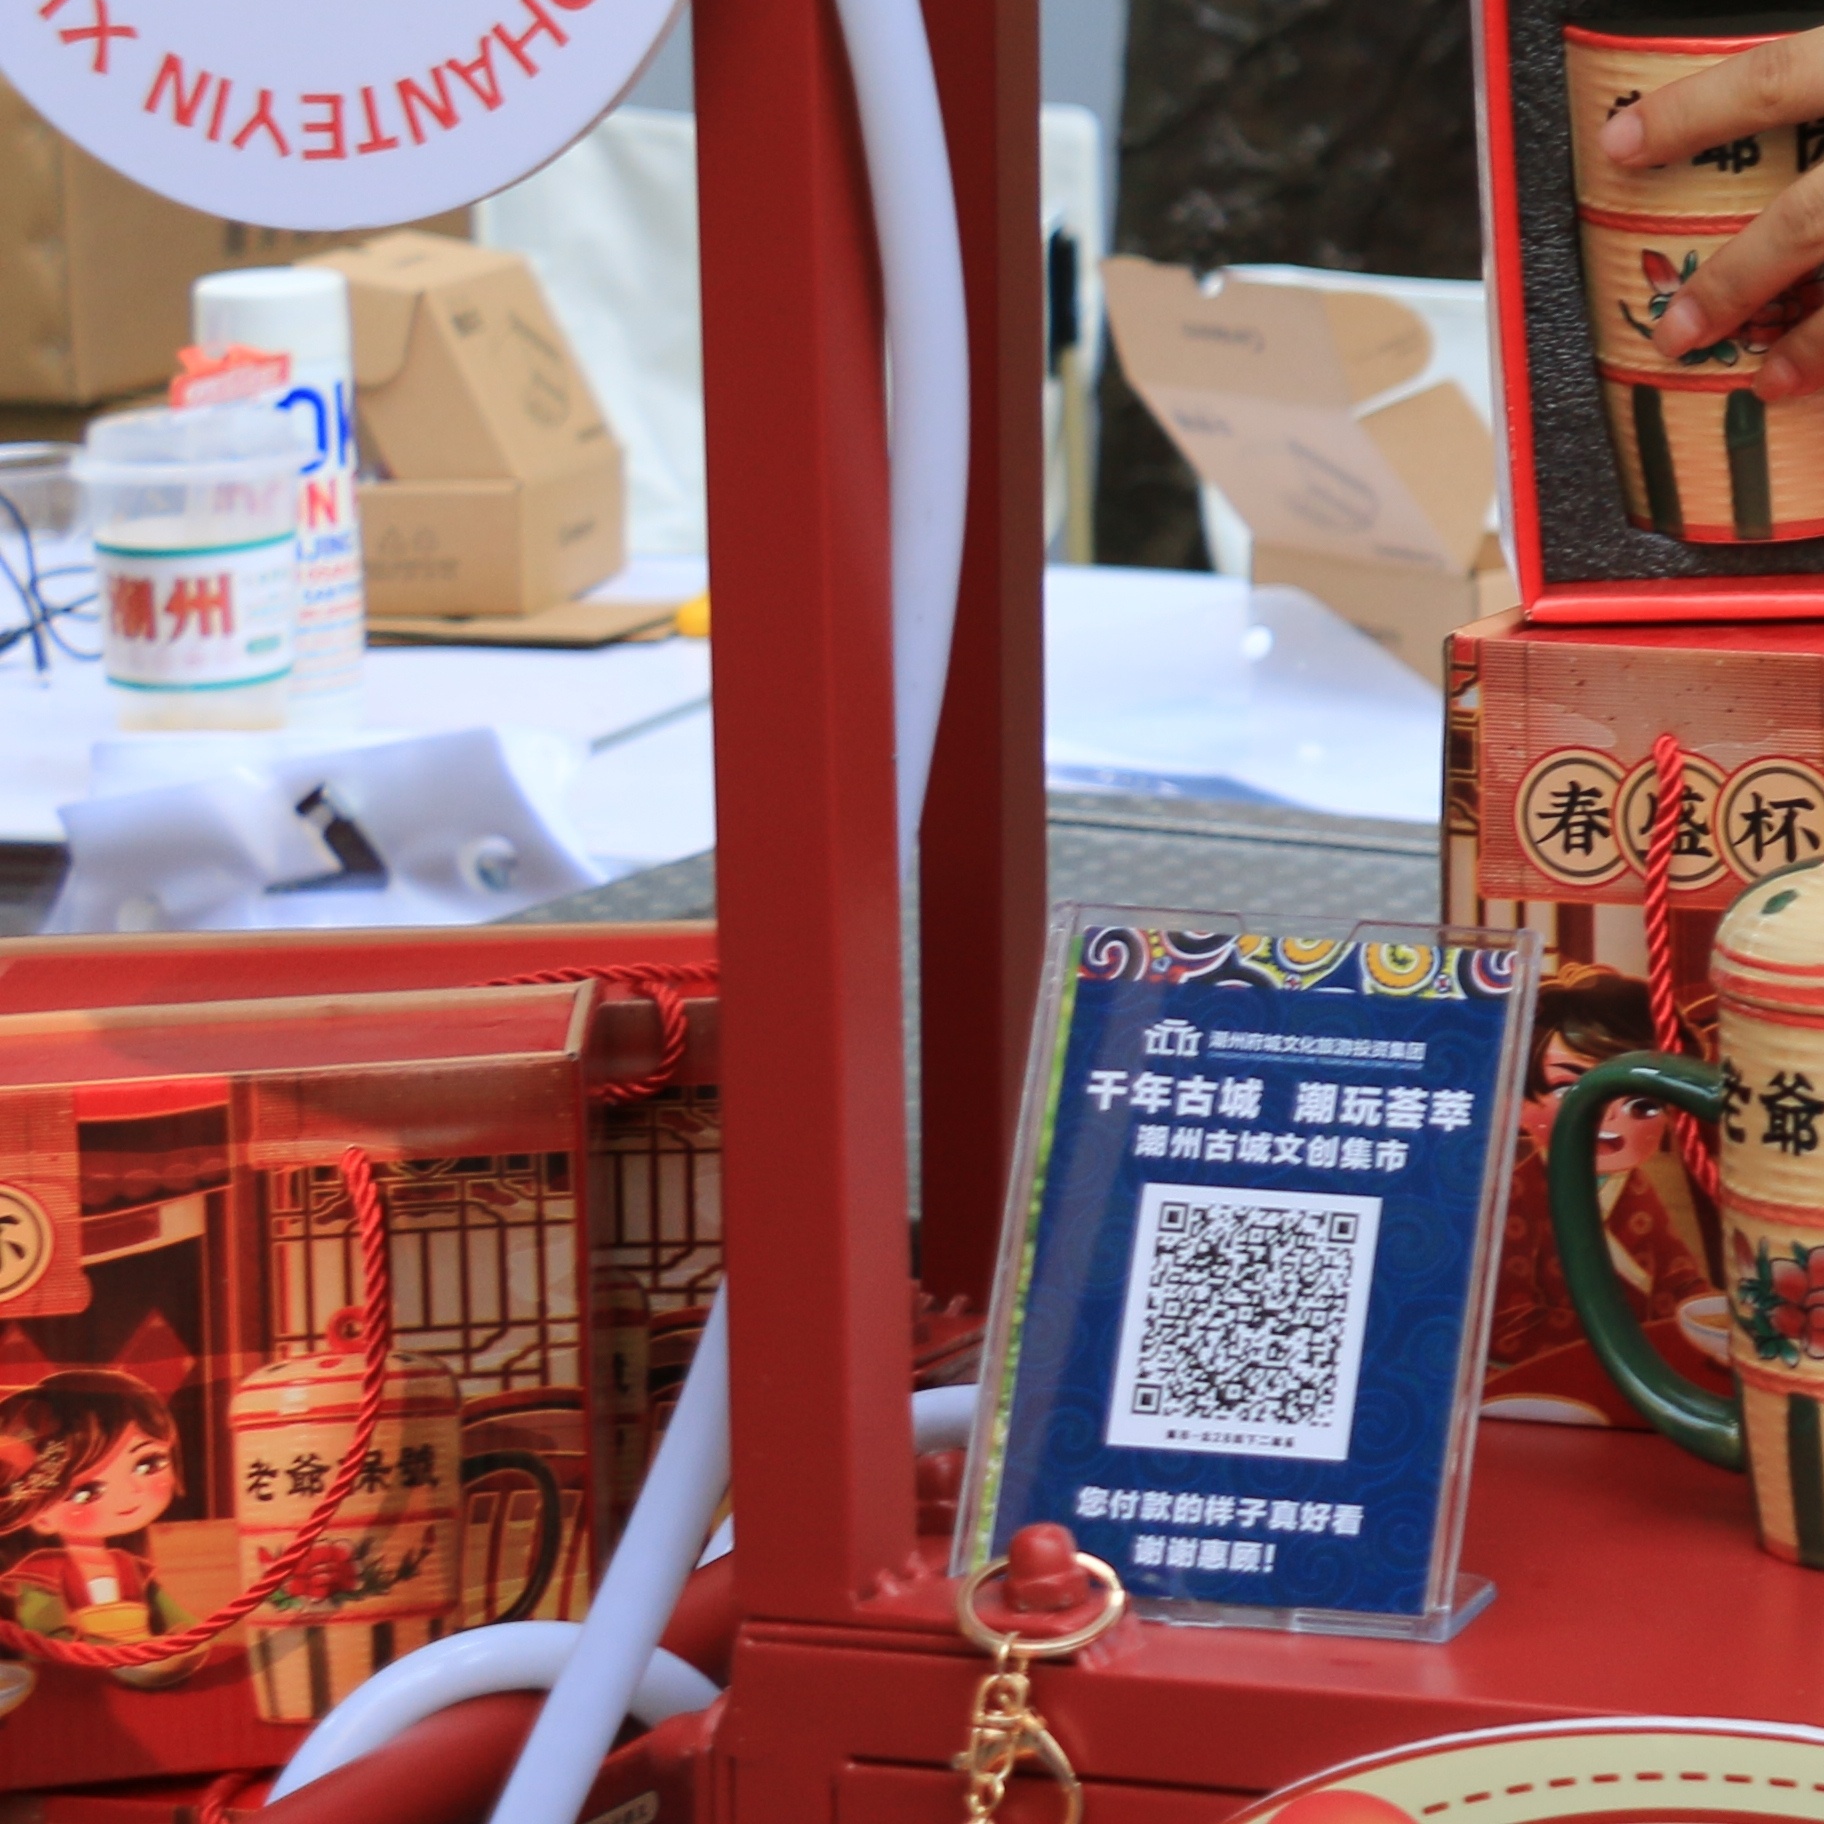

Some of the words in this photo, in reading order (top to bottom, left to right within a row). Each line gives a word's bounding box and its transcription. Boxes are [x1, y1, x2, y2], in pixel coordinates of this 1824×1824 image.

[1086, 1070, 1263, 1119] 千年古城
[1293, 1081, 1475, 1131] 潮玩荟萃
[1134, 1124, 1410, 1173] 潮州古城文创集市
[1074, 1486, 1364, 1536] 您付款的样子真好看
[1133, 1534, 1278, 1573] 谢谢惠顾！
